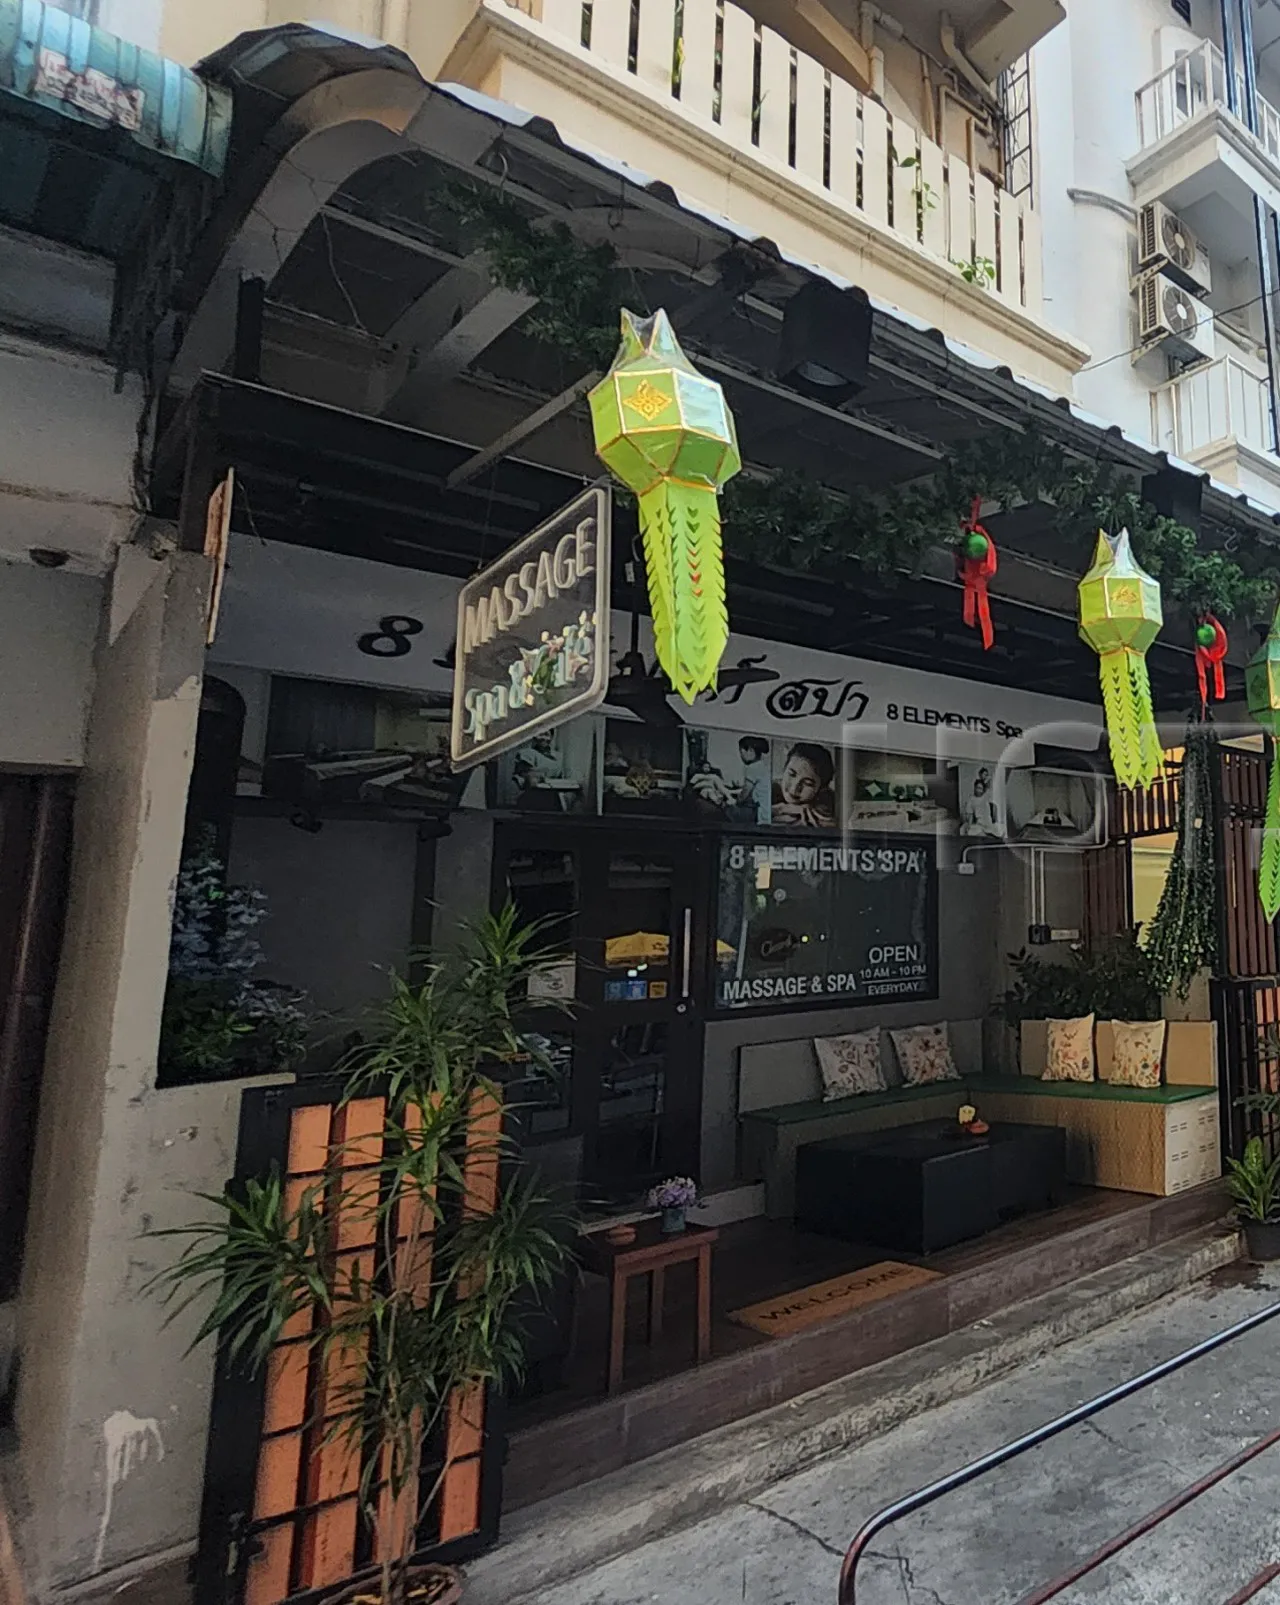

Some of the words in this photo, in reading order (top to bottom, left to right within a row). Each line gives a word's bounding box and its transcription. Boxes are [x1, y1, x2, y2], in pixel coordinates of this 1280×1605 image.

[464, 517, 596, 655] MASSAGE
[358, 616, 424, 657] 8
[766, 678, 870, 722] สปา
[886, 703, 899, 720] 8
[903, 705, 991, 733] ELEMENTS
[995, 720, 1023, 739] Spa
[729, 845, 745, 869] 8
[753, 846, 874, 872] ELEMENTS
[879, 849, 921, 873] SPA
[868, 945, 918, 964] OPEN
[860, 968, 872, 979] 10
[872, 967, 889, 978] AM
[899, 966, 910, 976] 10
[723, 978, 807, 1000] MASSAGE
[811, 976, 823, 993] &
[827, 974, 857, 992] SPA
[868, 983, 919, 996] EVERYDAY
